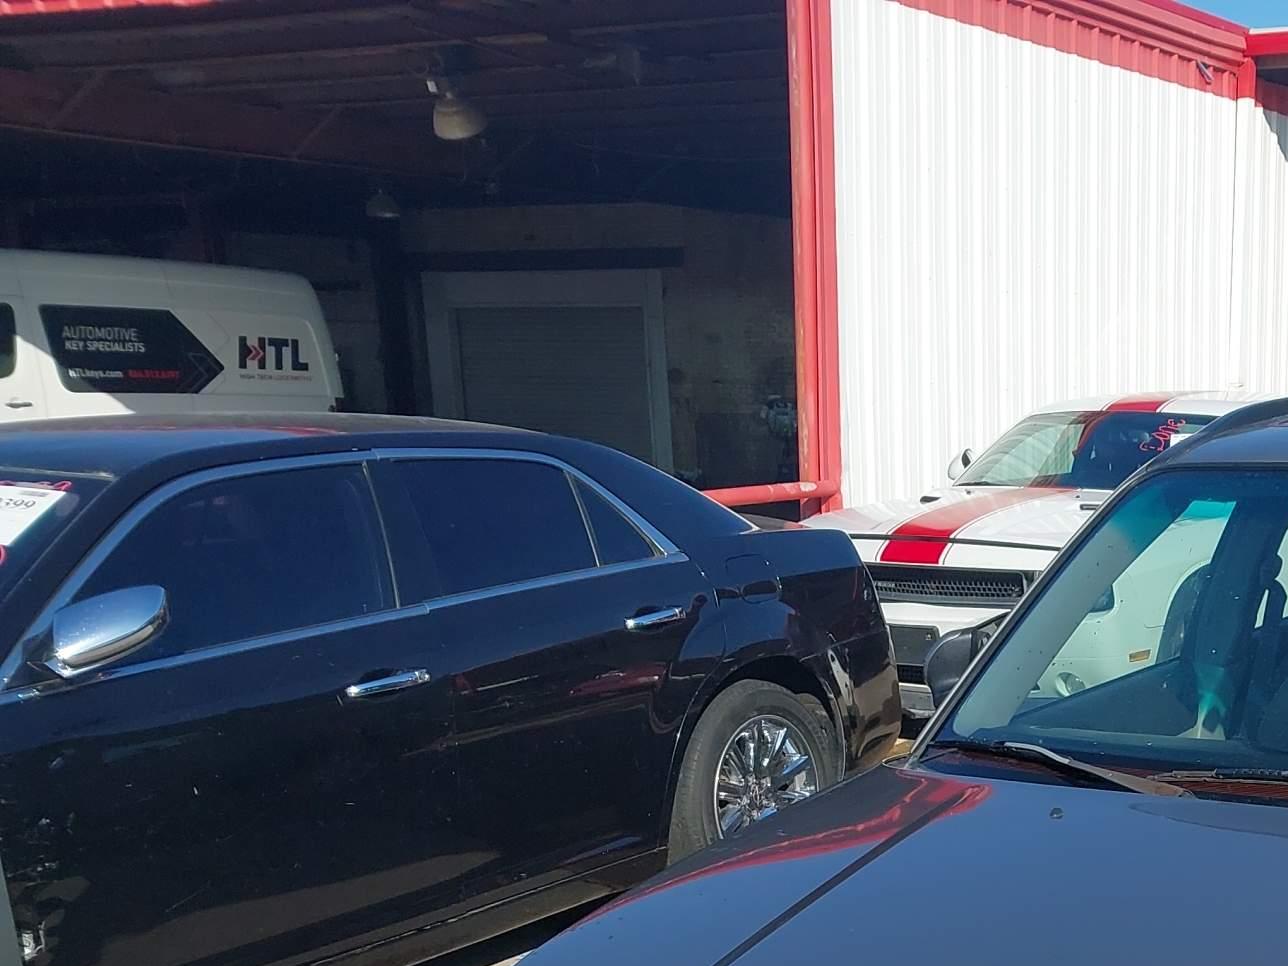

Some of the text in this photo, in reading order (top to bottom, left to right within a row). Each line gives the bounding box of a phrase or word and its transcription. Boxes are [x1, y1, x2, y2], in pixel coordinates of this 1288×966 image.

[62, 325, 140, 341] AUTOMOTIVE
[65, 340, 146, 353] KEY SPECIALISTS
[238, 335, 309, 371] HTL
